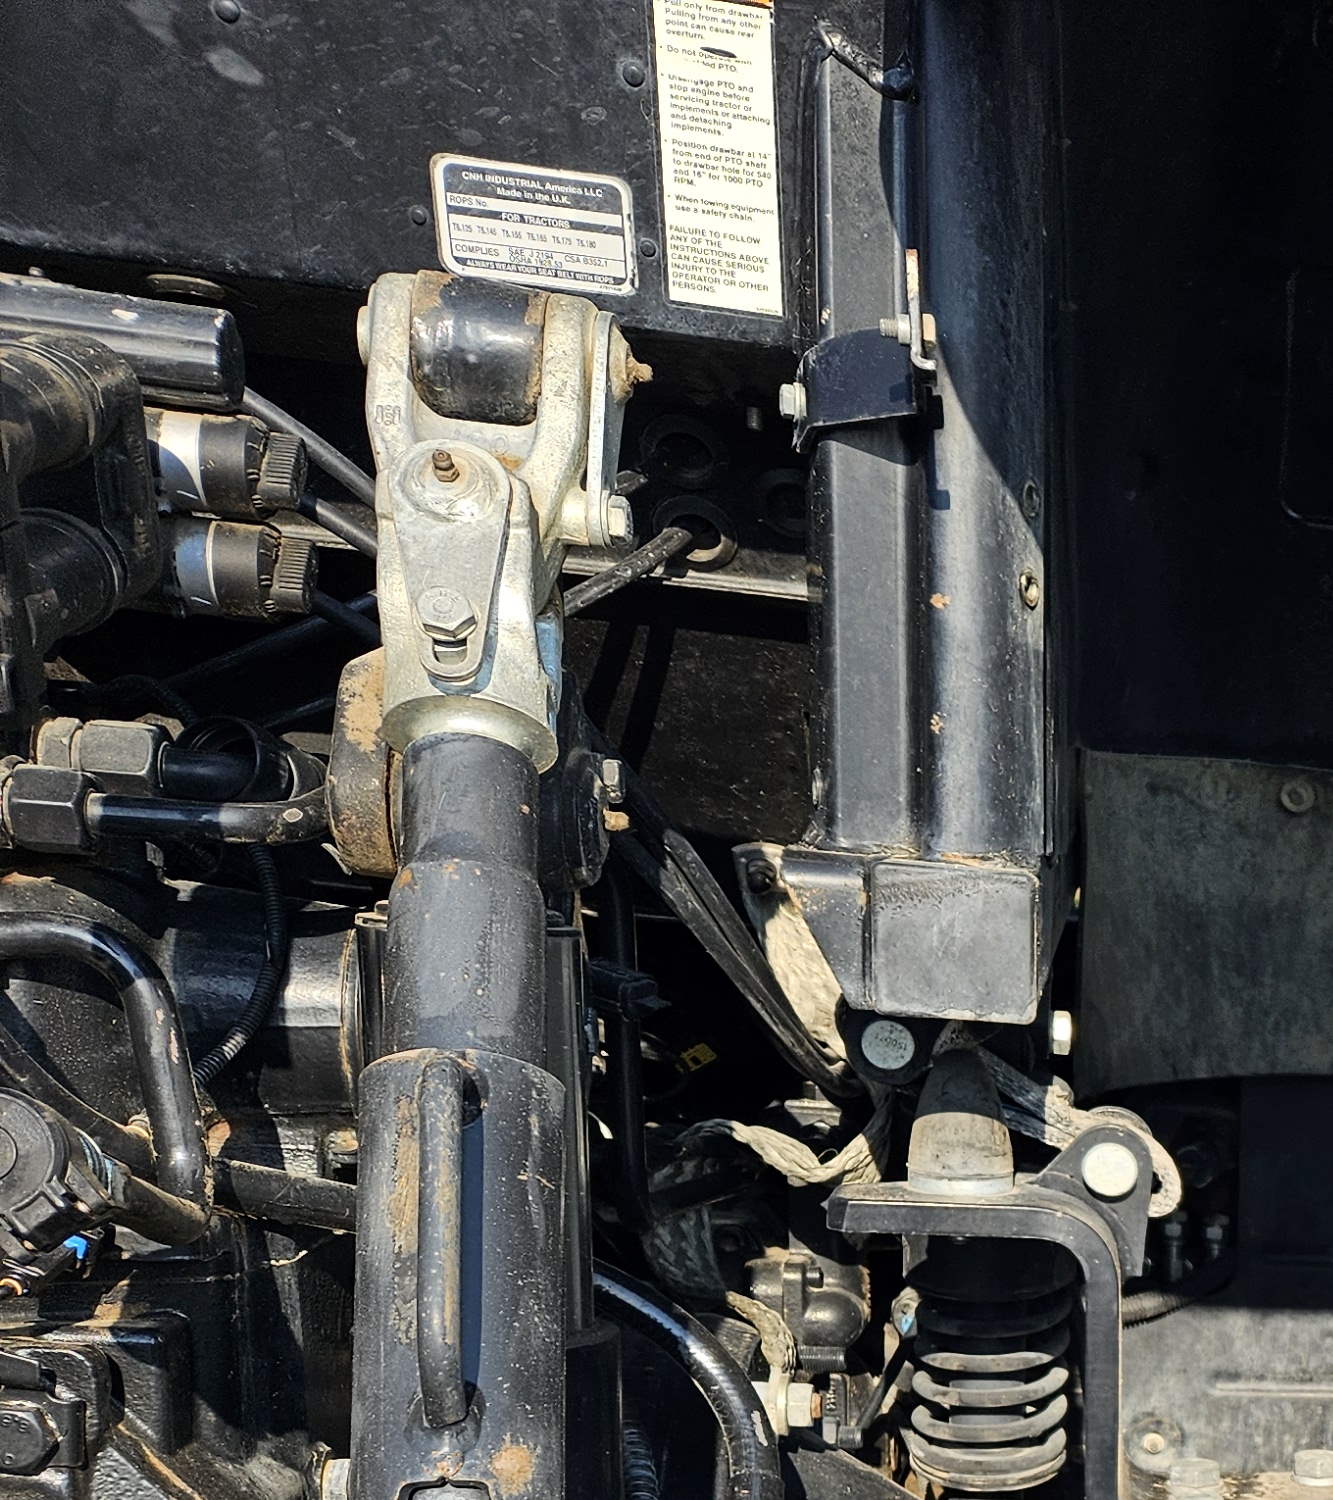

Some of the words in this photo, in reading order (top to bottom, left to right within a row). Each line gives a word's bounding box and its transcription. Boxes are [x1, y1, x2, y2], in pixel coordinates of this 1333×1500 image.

[683, 1, 702, 11] only
[705, 4, 725, 14] from
[665, 7, 695, 19] Pulling
[698, 12, 718, 22] from
[721, 18, 736, 26] any
[739, 19, 761, 29] other
[665, 18, 688, 28] point
[709, 26, 734, 34] cause
[666, 28, 705, 39] overturn.
[667, 44, 679, 53] Do
[681, 48, 696, 56] not
[718, 63, 738, 73] PTO.
[669, 83, 688, 92] stop
[690, 86, 720, 98] engine
[722, 91, 750, 101] before
[717, 80, 735, 89] PTO
[737, 84, 753, 92] and
[669, 93, 709, 106] servicing
[712, 99, 741, 110] tractor
[670, 102, 719, 116] implements
[732, 112, 770, 126] attaching
[670, 111, 687, 120] and
[689, 114, 732, 129] detaching
[671, 122, 724, 136] implements.
[672, 138, 707, 150] Position
[709, 144, 744, 156] drawbar
[672, 148, 692, 157] from
[694, 152, 711, 160] end
[713, 154, 722, 162] of
[725, 156, 742, 165] PTO
[745, 160, 766, 169] shaft
[673, 167, 689, 176] and
[708, 172, 720, 180] for
[723, 175, 742, 184] 1000
[745, 178, 763, 187] PTO
[684, 159, 718, 171] drawbar
[721, 165, 740, 174] hole
[742, 168, 754, 176] for
[757, 171, 771, 179] 540
[461, 171, 483, 181] CNH
[485, 174, 543, 189] INDUSTRIAL
[544, 181, 582, 194] America
[584, 187, 603, 197] LLC
[674, 176, 696, 186] RPM.
[449, 194, 473, 205] ROPS
[475, 198, 489, 207] No.
[496, 187, 521, 197] Made
[524, 190, 533, 199] in
[535, 192, 549, 201] the
[551, 194, 571, 204] U.K.
[675, 193, 698, 204] When
[700, 198, 729, 210] towing
[730, 203, 774, 217] equipment
[675, 204, 691, 212] use
[701, 207, 726, 219] safety
[729, 211, 755, 222] chain.
[501, 212, 520, 222] FOR
[524, 215, 570, 228] TRACTORS
[669, 224, 707, 236] FAILURE
[709, 230, 720, 238] TO
[723, 232, 760, 244] FOLLOW
[670, 234, 688, 242] ANY
[691, 237, 703, 245] OF
[705, 239, 723, 248] THE
[455, 244, 499, 256] COMPLIES
[508, 247, 524, 256] SAE
[564, 255, 581, 263] CSA
[670, 243, 736, 259] INSTRUCTIONS
[739, 253, 769, 264] ABOVE
[509, 255, 532, 264] OSHA
[671, 252, 690, 261] CAN
[692, 255, 723, 266] CAUSE
[725, 261, 764, 273] SERIOUS
[466, 258, 494, 269] ALWAYS
[495, 262, 516, 271] WEAR
[518, 265, 537, 274] YOUR
[538, 267, 556, 276] SEAT
[557, 270, 574, 279] BELT
[576, 272, 593, 281] WITH
[594, 274, 614, 284] ROPS
[671, 262, 703, 272] INJURY
[705, 267, 717, 275] TO
[719, 269, 736, 277] THE
[672, 271, 720, 284] OPERATOR
[723, 278, 736, 286] OR
[739, 280, 768, 291] OTHER
[672, 280, 717, 293] PERSONS.
